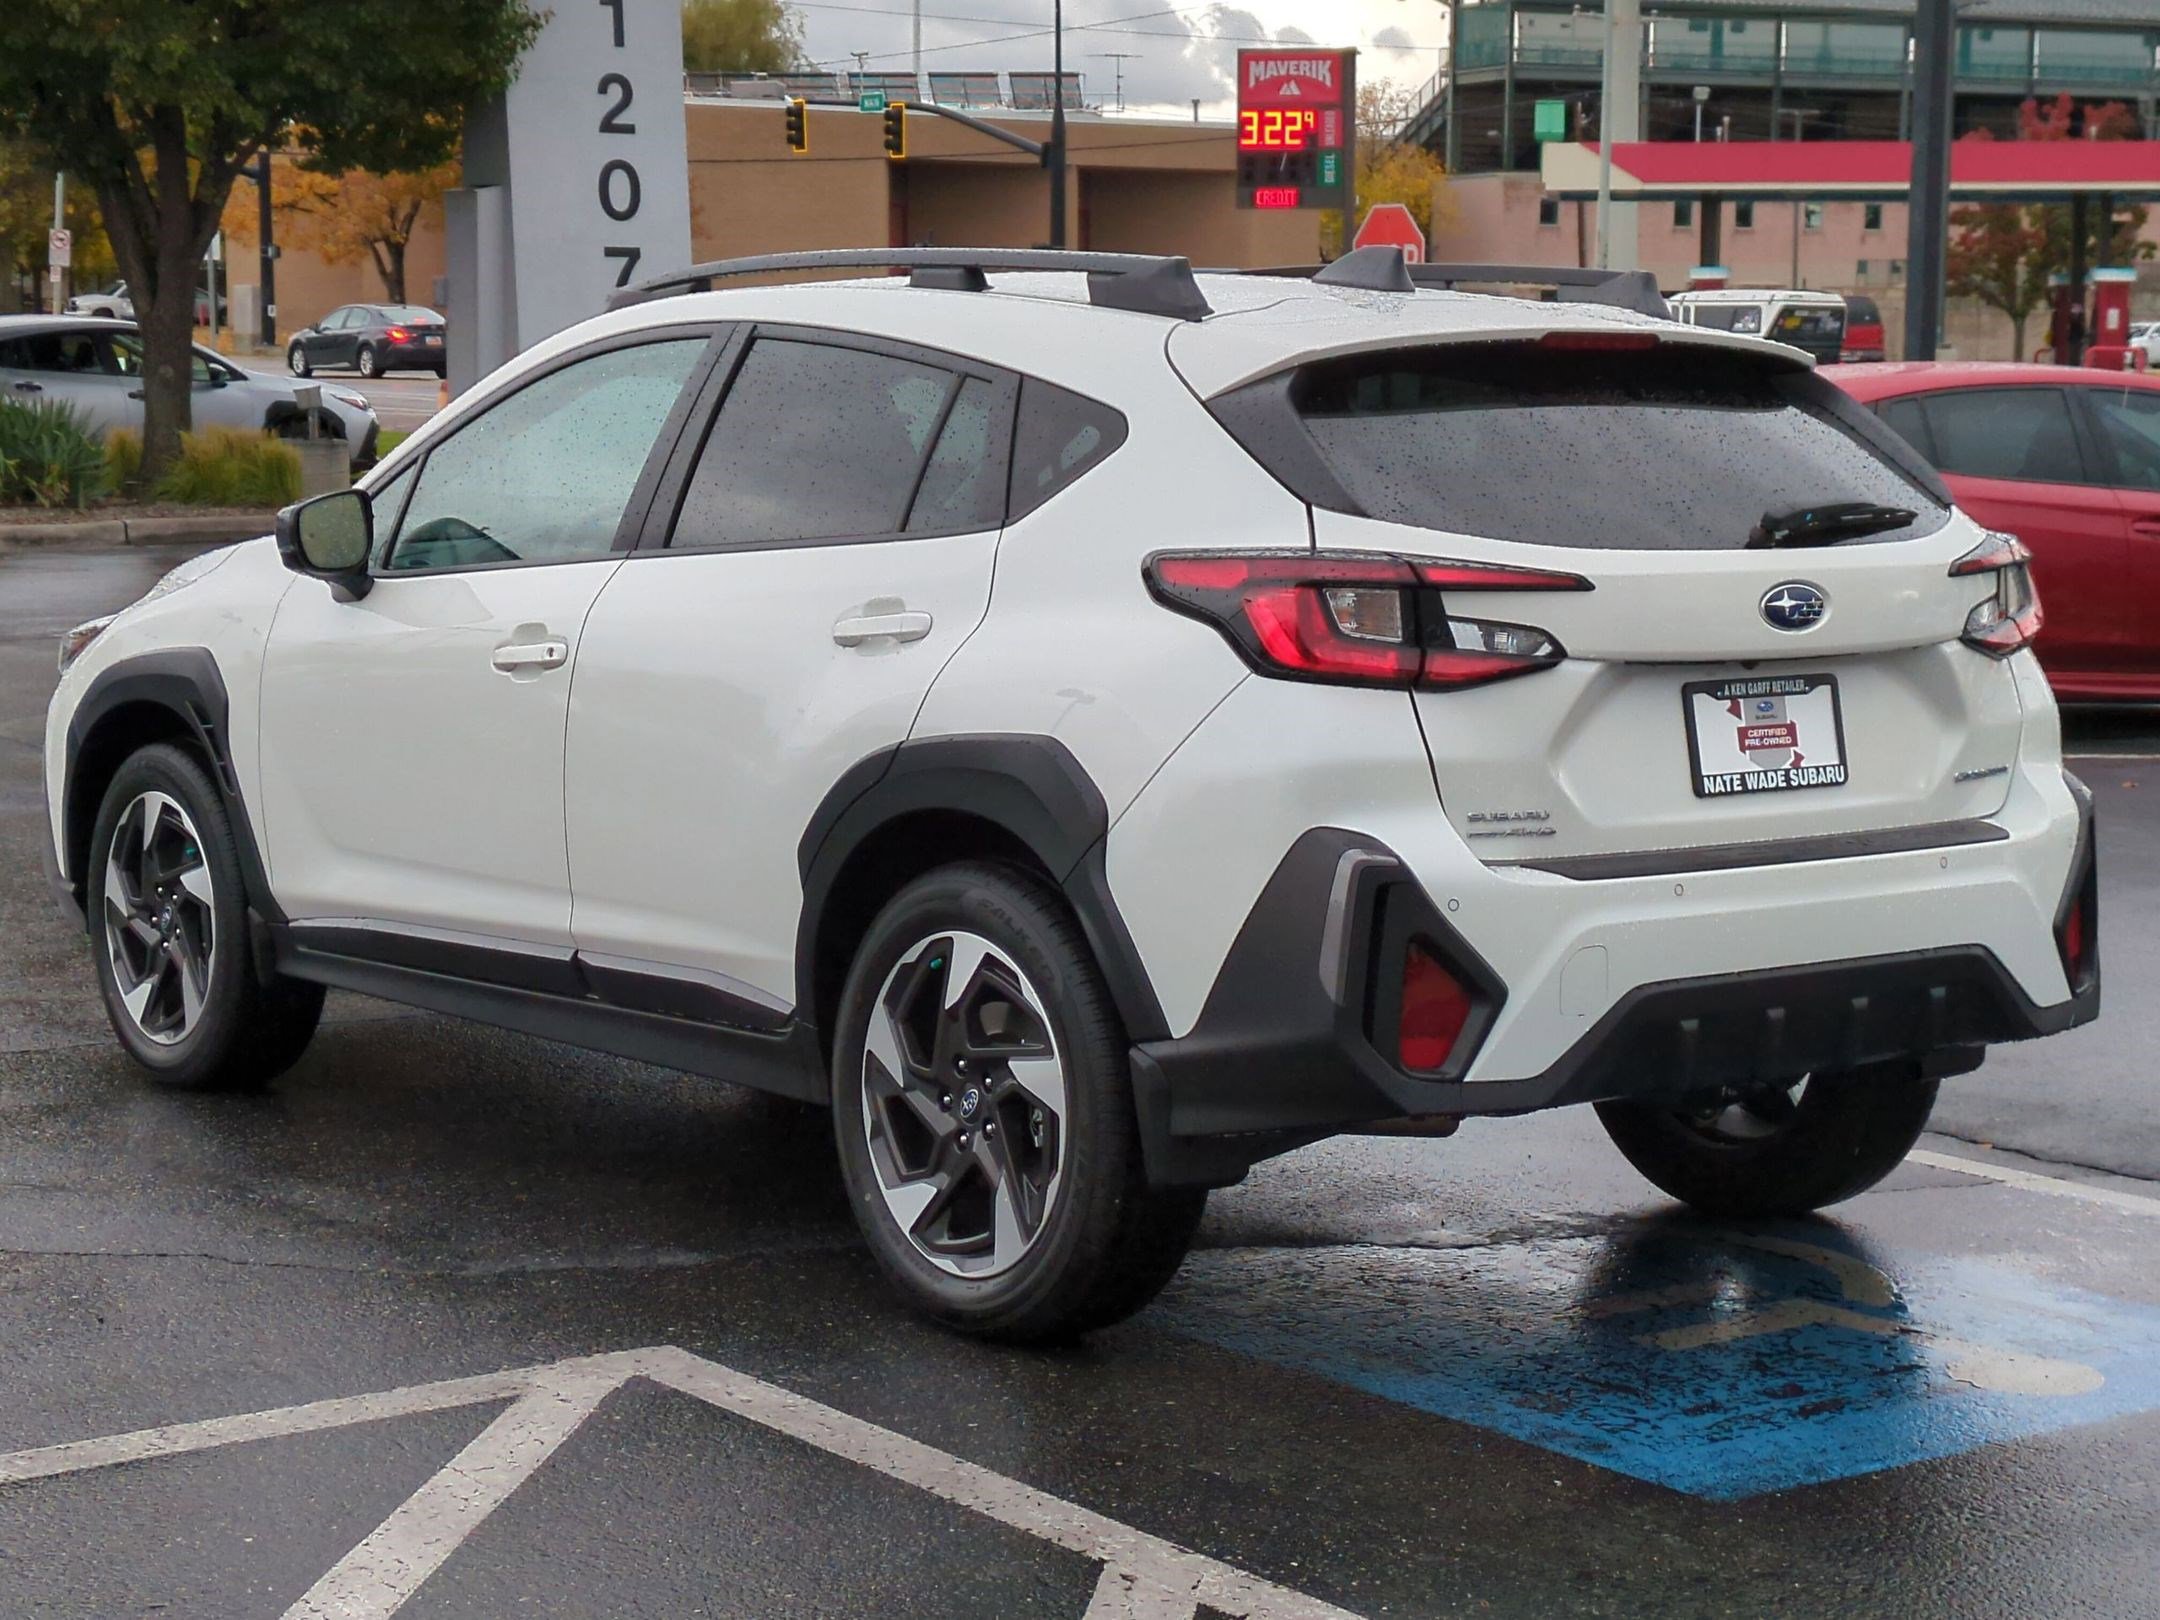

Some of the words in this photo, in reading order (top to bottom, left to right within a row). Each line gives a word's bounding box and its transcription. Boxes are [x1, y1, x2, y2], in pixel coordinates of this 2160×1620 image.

[1248, 60, 1332, 88] MAVERIK
[1324, 154, 1335, 183] DIESEL
[1256, 190, 1296, 205] CREDIT
[1731, 684, 1747, 696] KEN
[1748, 681, 1771, 694] GARFF
[1772, 679, 1805, 693] RETAILER
[1748, 727, 1788, 738] CERTIFIED
[1744, 736, 1792, 747] PRE-OWNED
[1703, 774, 1743, 794] NATE
[1744, 770, 1786, 790] WADE
[1790, 765, 1845, 786] SUBARU
[1467, 809, 1550, 823] SUBARU
